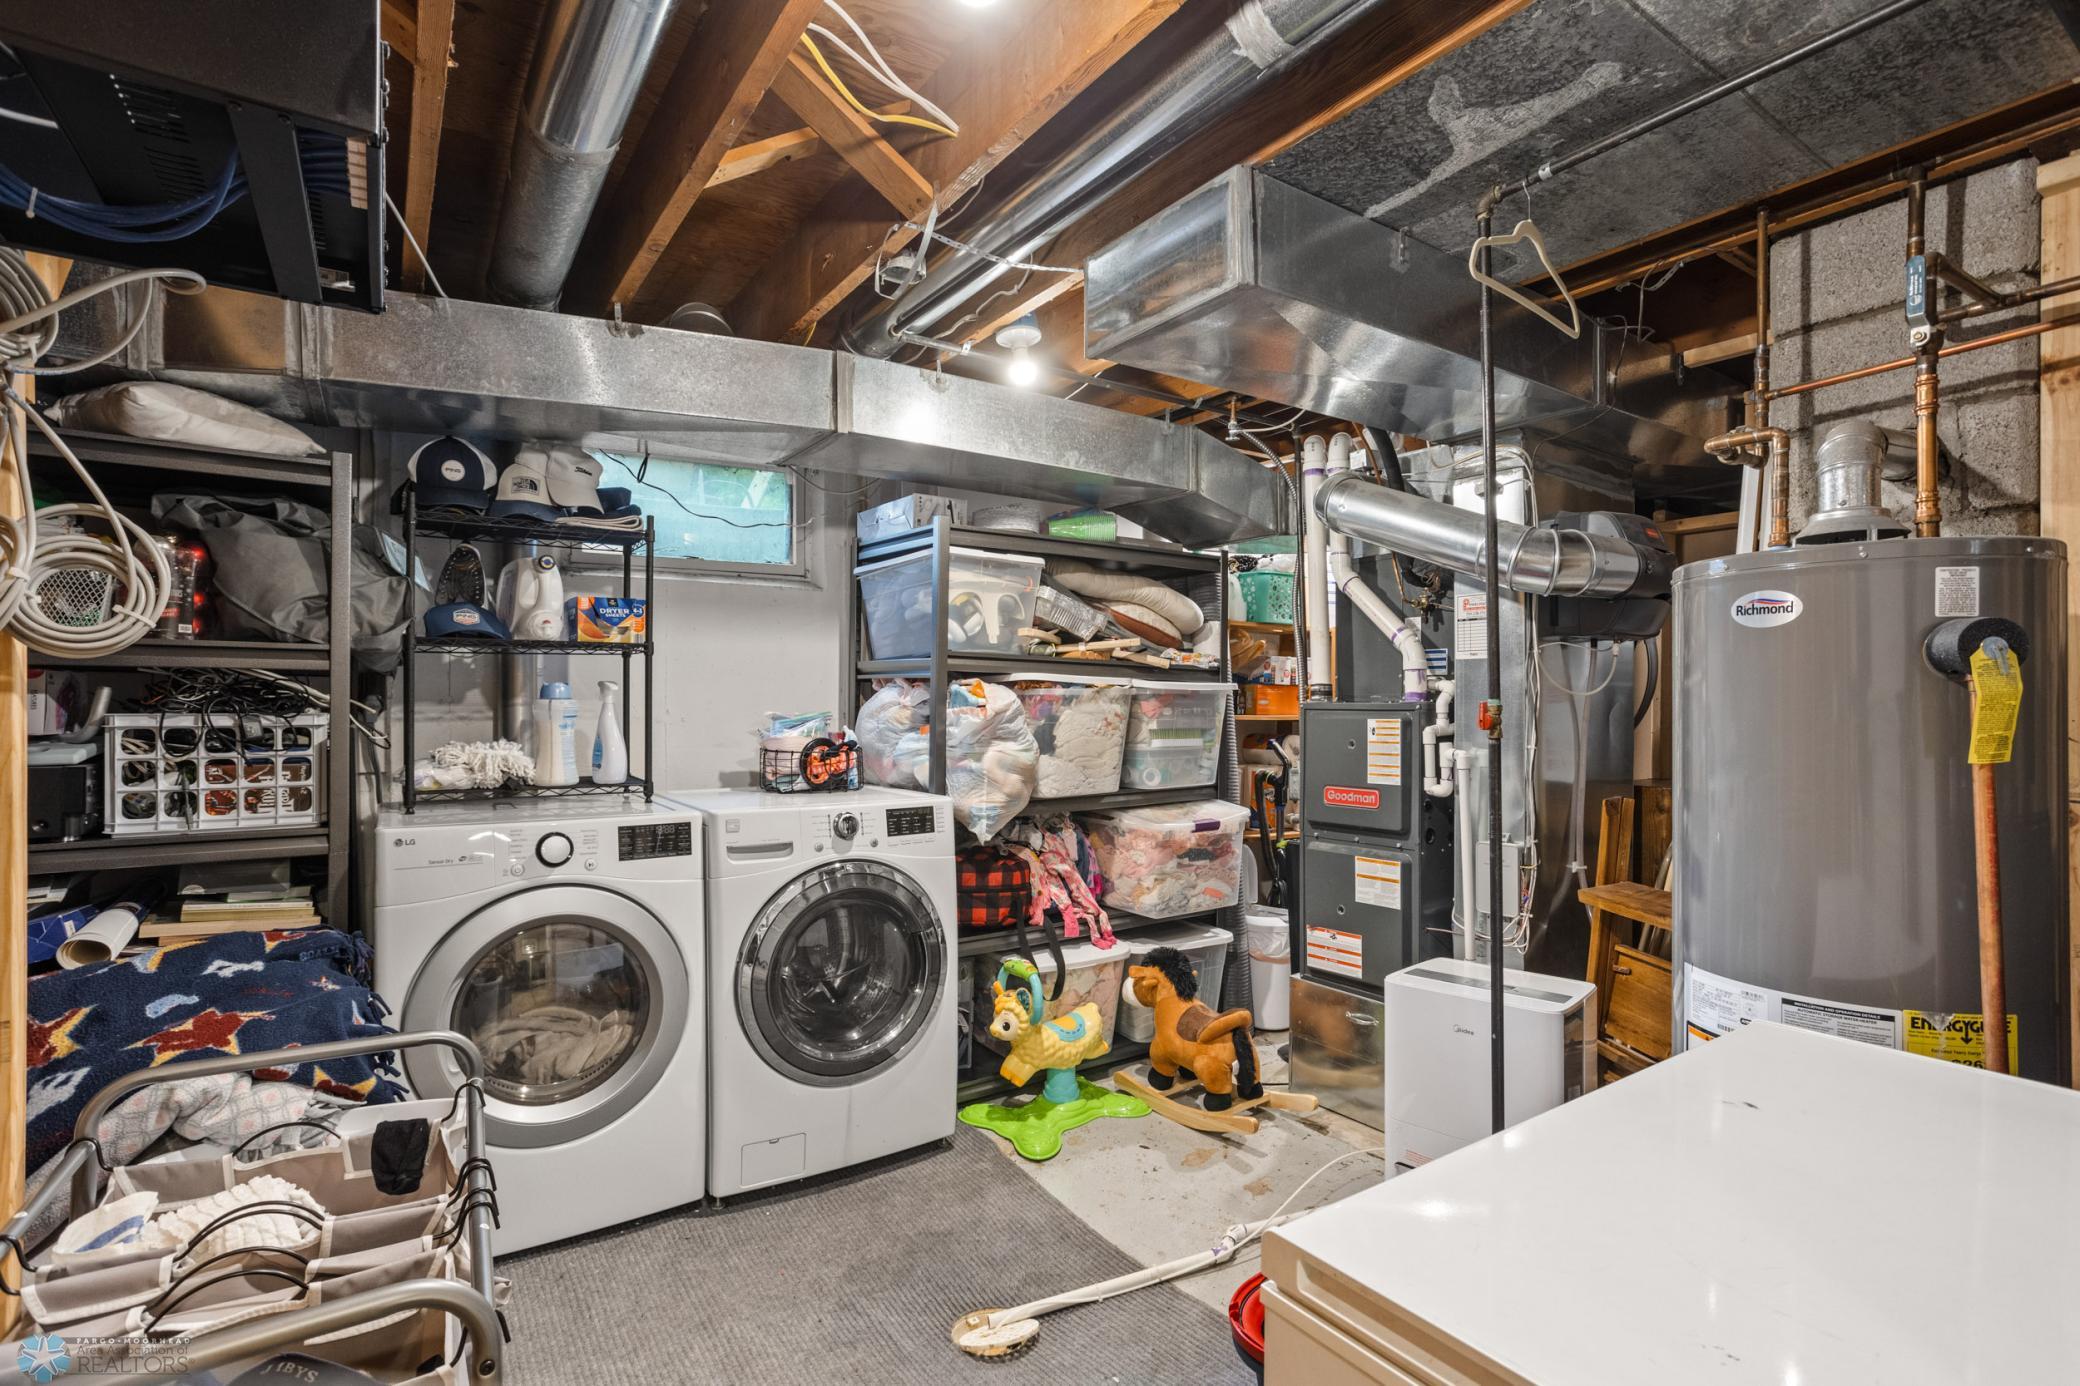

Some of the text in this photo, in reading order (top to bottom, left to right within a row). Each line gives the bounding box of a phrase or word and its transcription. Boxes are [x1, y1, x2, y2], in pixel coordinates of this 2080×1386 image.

[600, 607, 630, 615] DRYER
[1736, 600, 1794, 617] Richmond
[1327, 790, 1376, 803] Goodman
[404, 838, 416, 846] LG
